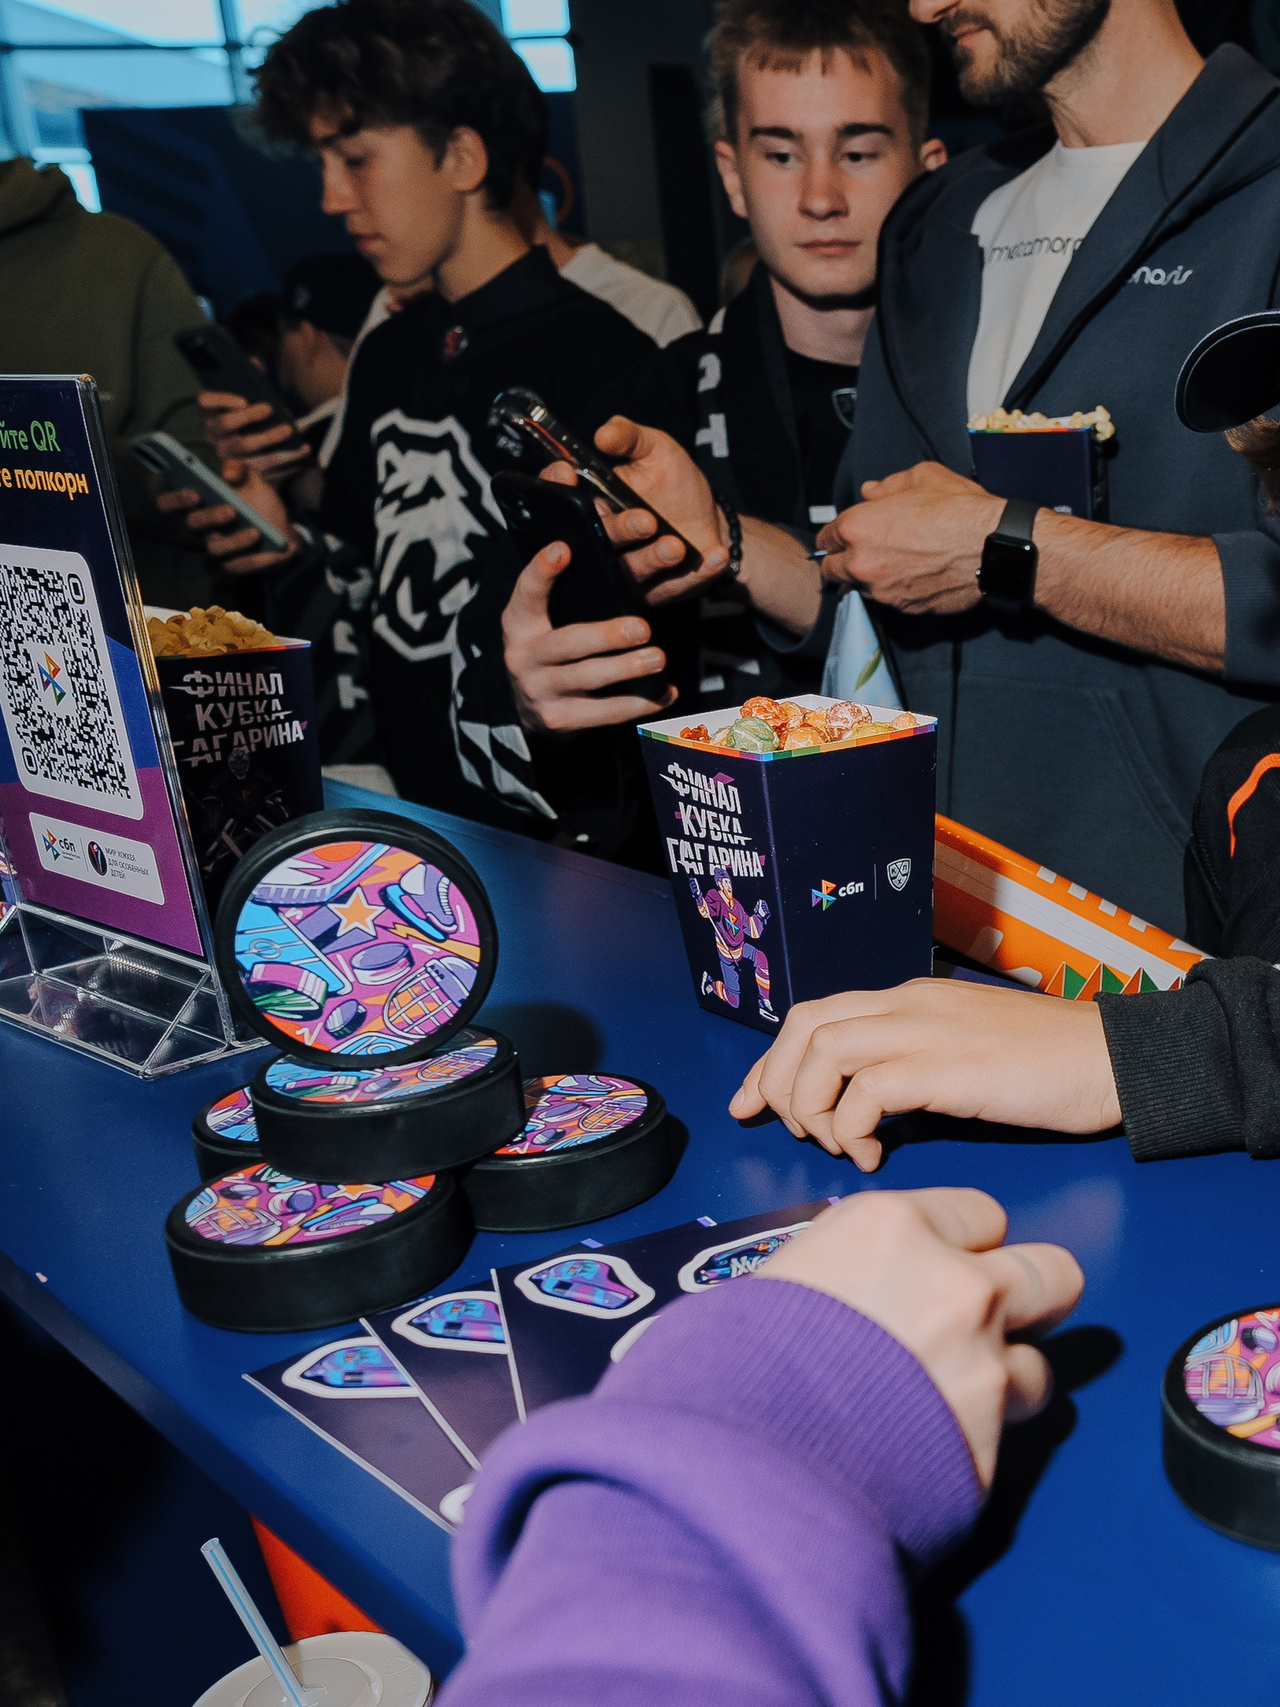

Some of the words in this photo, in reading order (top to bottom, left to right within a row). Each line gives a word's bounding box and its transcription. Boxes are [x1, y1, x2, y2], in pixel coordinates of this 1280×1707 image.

[30, 420, 61, 452] QR
[14, 469, 90, 501] попкорн
[168, 670, 285, 698] ФИНАЛ
[195, 698, 293, 732] КУБКА
[172, 719, 305, 768] АГАРИНА
[660, 761, 742, 815] ФИНАЛ
[676, 801, 752, 846] КУБКА
[59, 838, 76, 852] сбп
[665, 836, 764, 878] ГАГАРИНА
[837, 881, 864, 898] сбп
